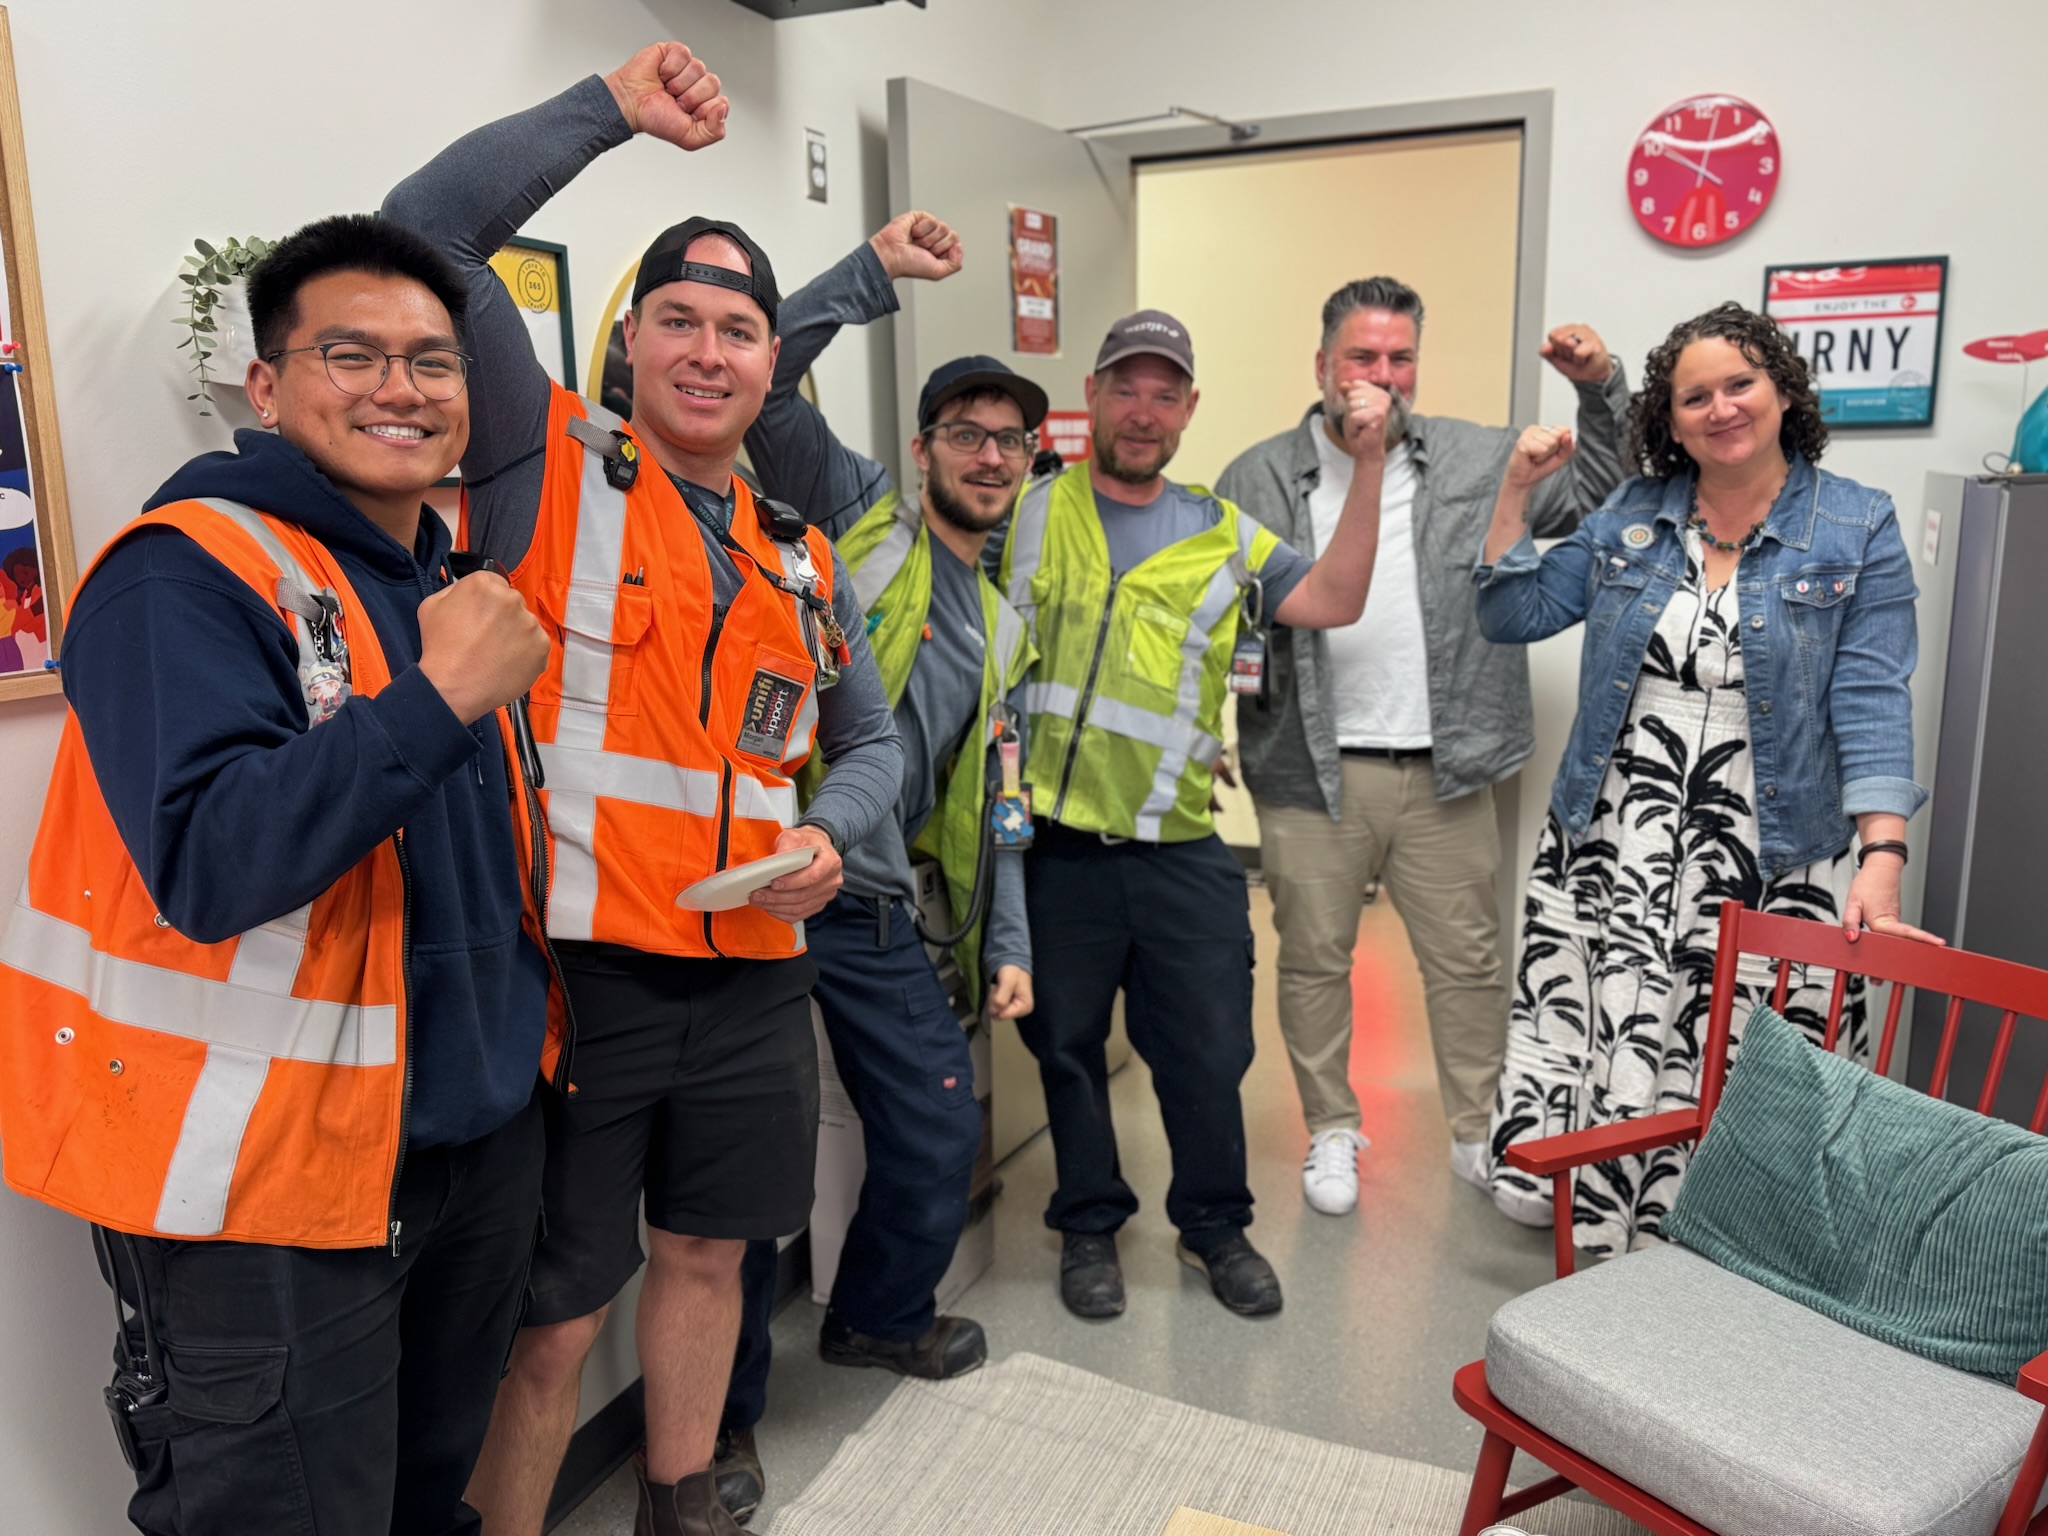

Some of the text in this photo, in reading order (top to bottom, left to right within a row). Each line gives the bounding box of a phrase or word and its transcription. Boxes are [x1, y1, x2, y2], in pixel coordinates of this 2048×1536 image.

[1665, 114, 1682, 132] 11
[1734, 108, 1741, 126] 1
[1644, 137, 1664, 157] 10
[1758, 156, 1774, 175] 3
[1633, 168, 1648, 187] 9
[1747, 187, 1762, 205] 4
[1640, 197, 1655, 215] 8
[1662, 216, 1676, 234] 7
[1724, 211, 1739, 229] 5
[1692, 222, 1707, 240] 6
[528, 281, 541, 290] 365
[1814, 299, 1888, 312] ENJOY THE
[697, 504, 718, 529] WESTJET
[751, 676, 775, 721] unifi
[765, 689, 789, 736] upport
[743, 731, 764, 744] Morgan
